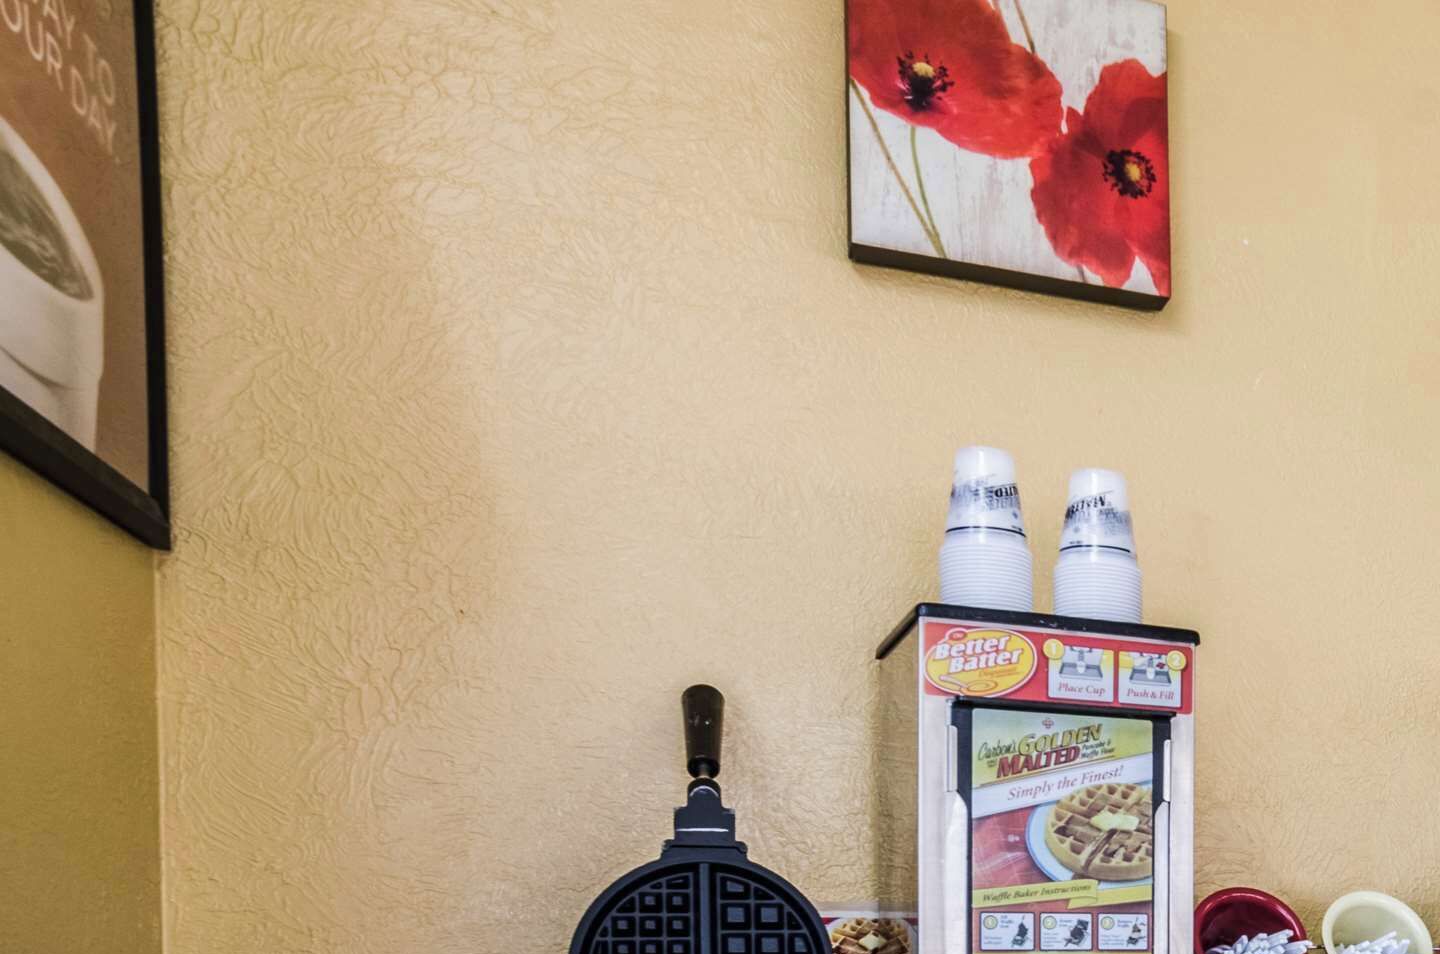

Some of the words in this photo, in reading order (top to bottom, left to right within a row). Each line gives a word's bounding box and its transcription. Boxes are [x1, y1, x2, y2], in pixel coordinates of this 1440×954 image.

[0, 0, 63, 91] OUR
[32, 0, 75, 50] AY
[82, 32, 115, 107] TO
[935, 635, 1011, 660] Better
[949, 649, 1024, 673] Batter
[1058, 681, 1083, 693] Place
[1086, 685, 1106, 697] Cup
[1127, 688, 1149, 698] Push
[1159, 690, 1175, 701] Fill
[1018, 723, 1103, 757] GOLDEN
[996, 745, 1081, 779] MALTED
[1008, 780, 1055, 801] Simply
[1057, 774, 1077, 792] the
[1080, 765, 1124, 784] Finest!
